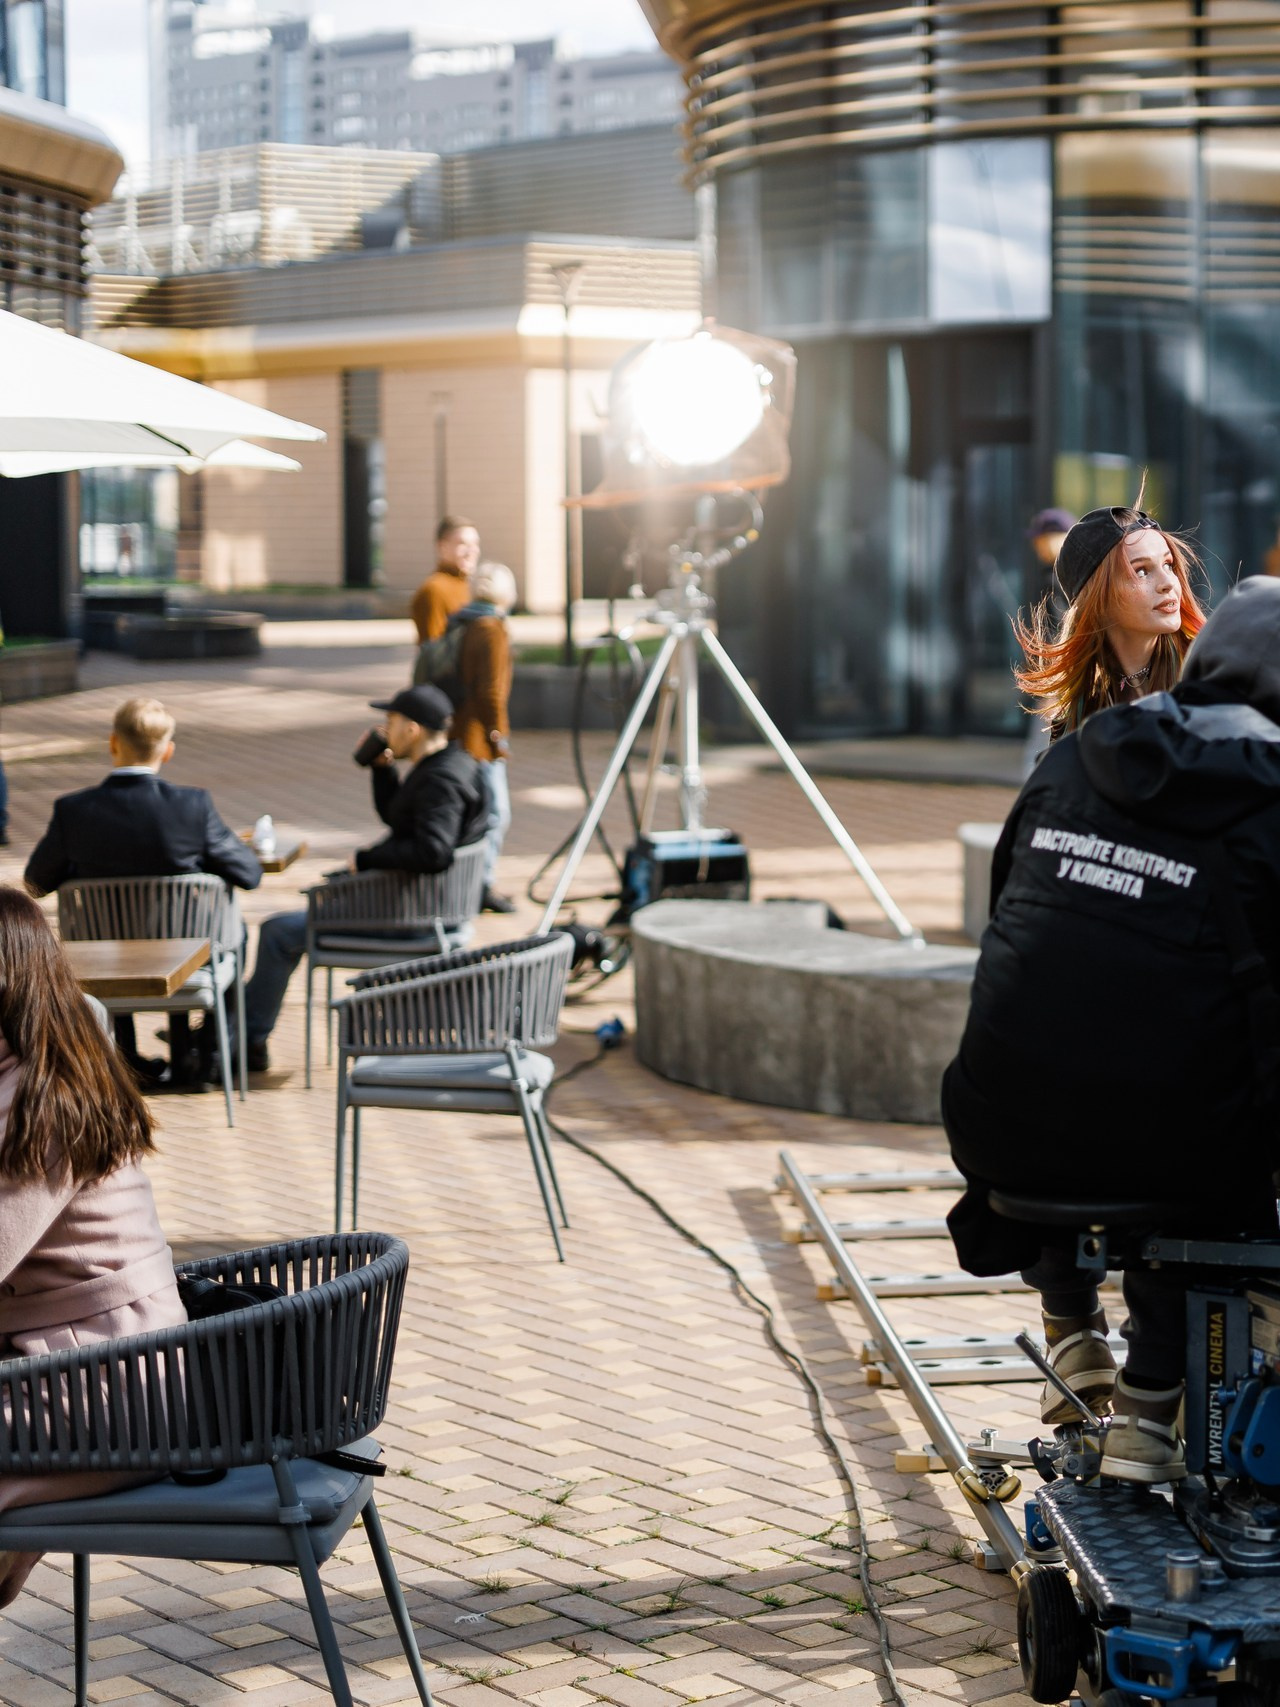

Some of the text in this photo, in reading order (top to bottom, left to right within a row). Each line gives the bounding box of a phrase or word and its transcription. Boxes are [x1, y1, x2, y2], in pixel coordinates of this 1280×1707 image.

[1031, 827, 1197, 887] НАСТРОЙТЕ КОНТРАСТ
[1057, 857, 1144, 898] У КЛИЕНТА
[1209, 1312, 1223, 1375] CINEMA
